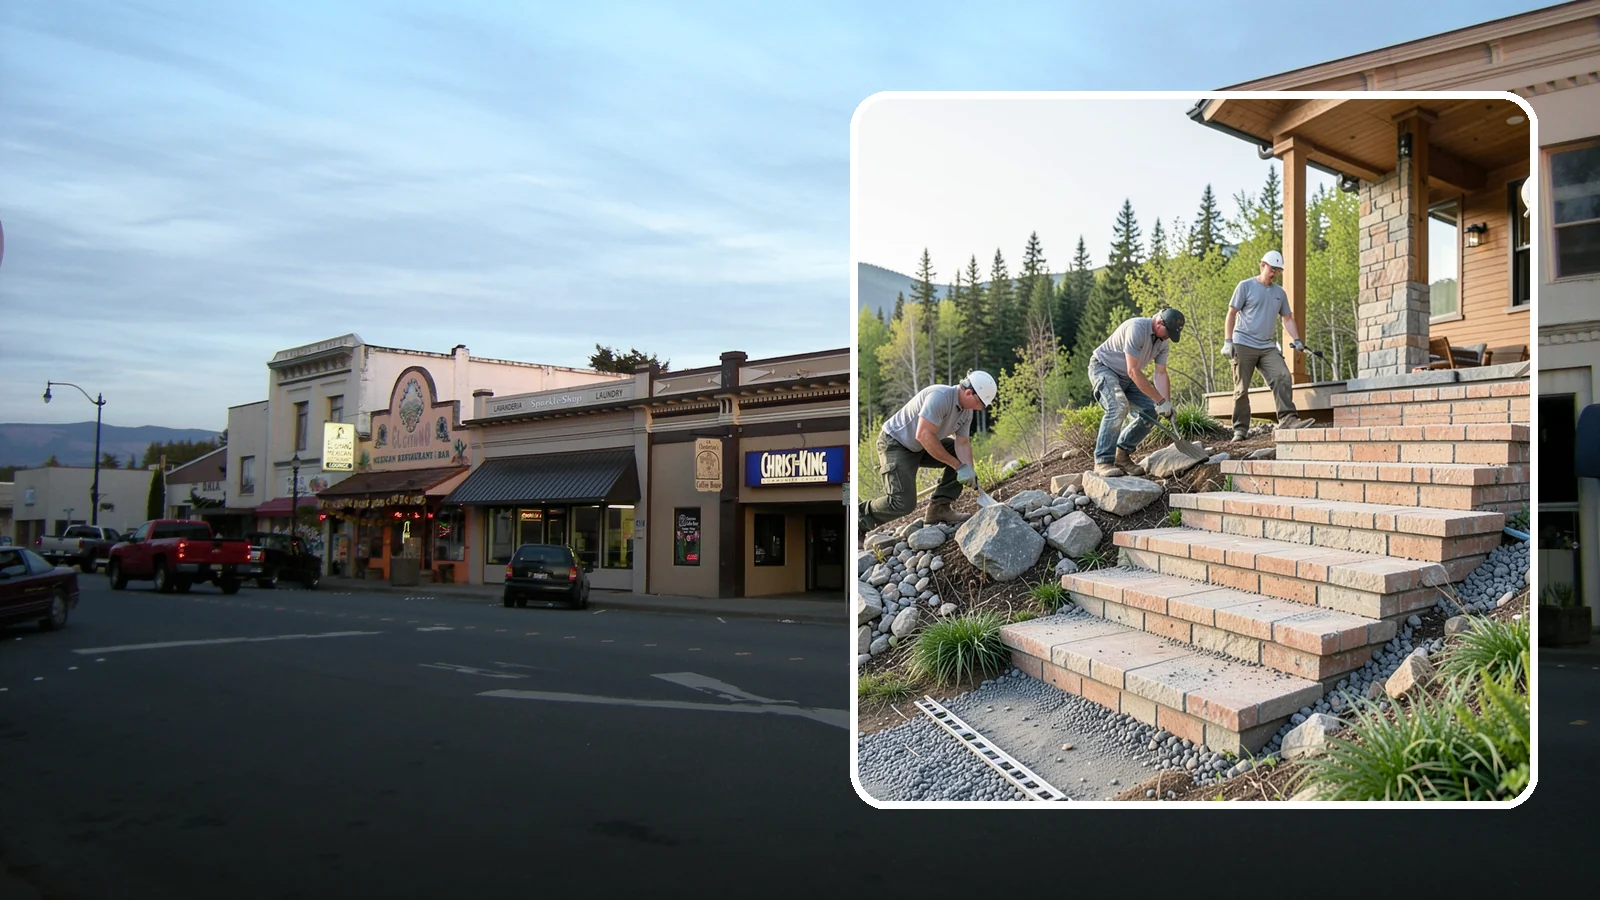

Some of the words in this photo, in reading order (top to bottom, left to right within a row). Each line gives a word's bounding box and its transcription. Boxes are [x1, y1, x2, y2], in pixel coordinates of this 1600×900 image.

[595, 389, 623, 400] LAUNDRY
[493, 402, 522, 413] LAVANDERIA
[530, 396, 561, 409] Sparkle
[561, 394, 582, 405] Shop
[373, 455, 396, 464] MEXICAN
[397, 451, 433, 462] RESTAURANT
[437, 450, 450, 459] BAR
[760, 452, 797, 477] CHRIST
[799, 450, 827, 477] KING
[696, 481, 709, 489] Coffee
[710, 481, 722, 489] House
